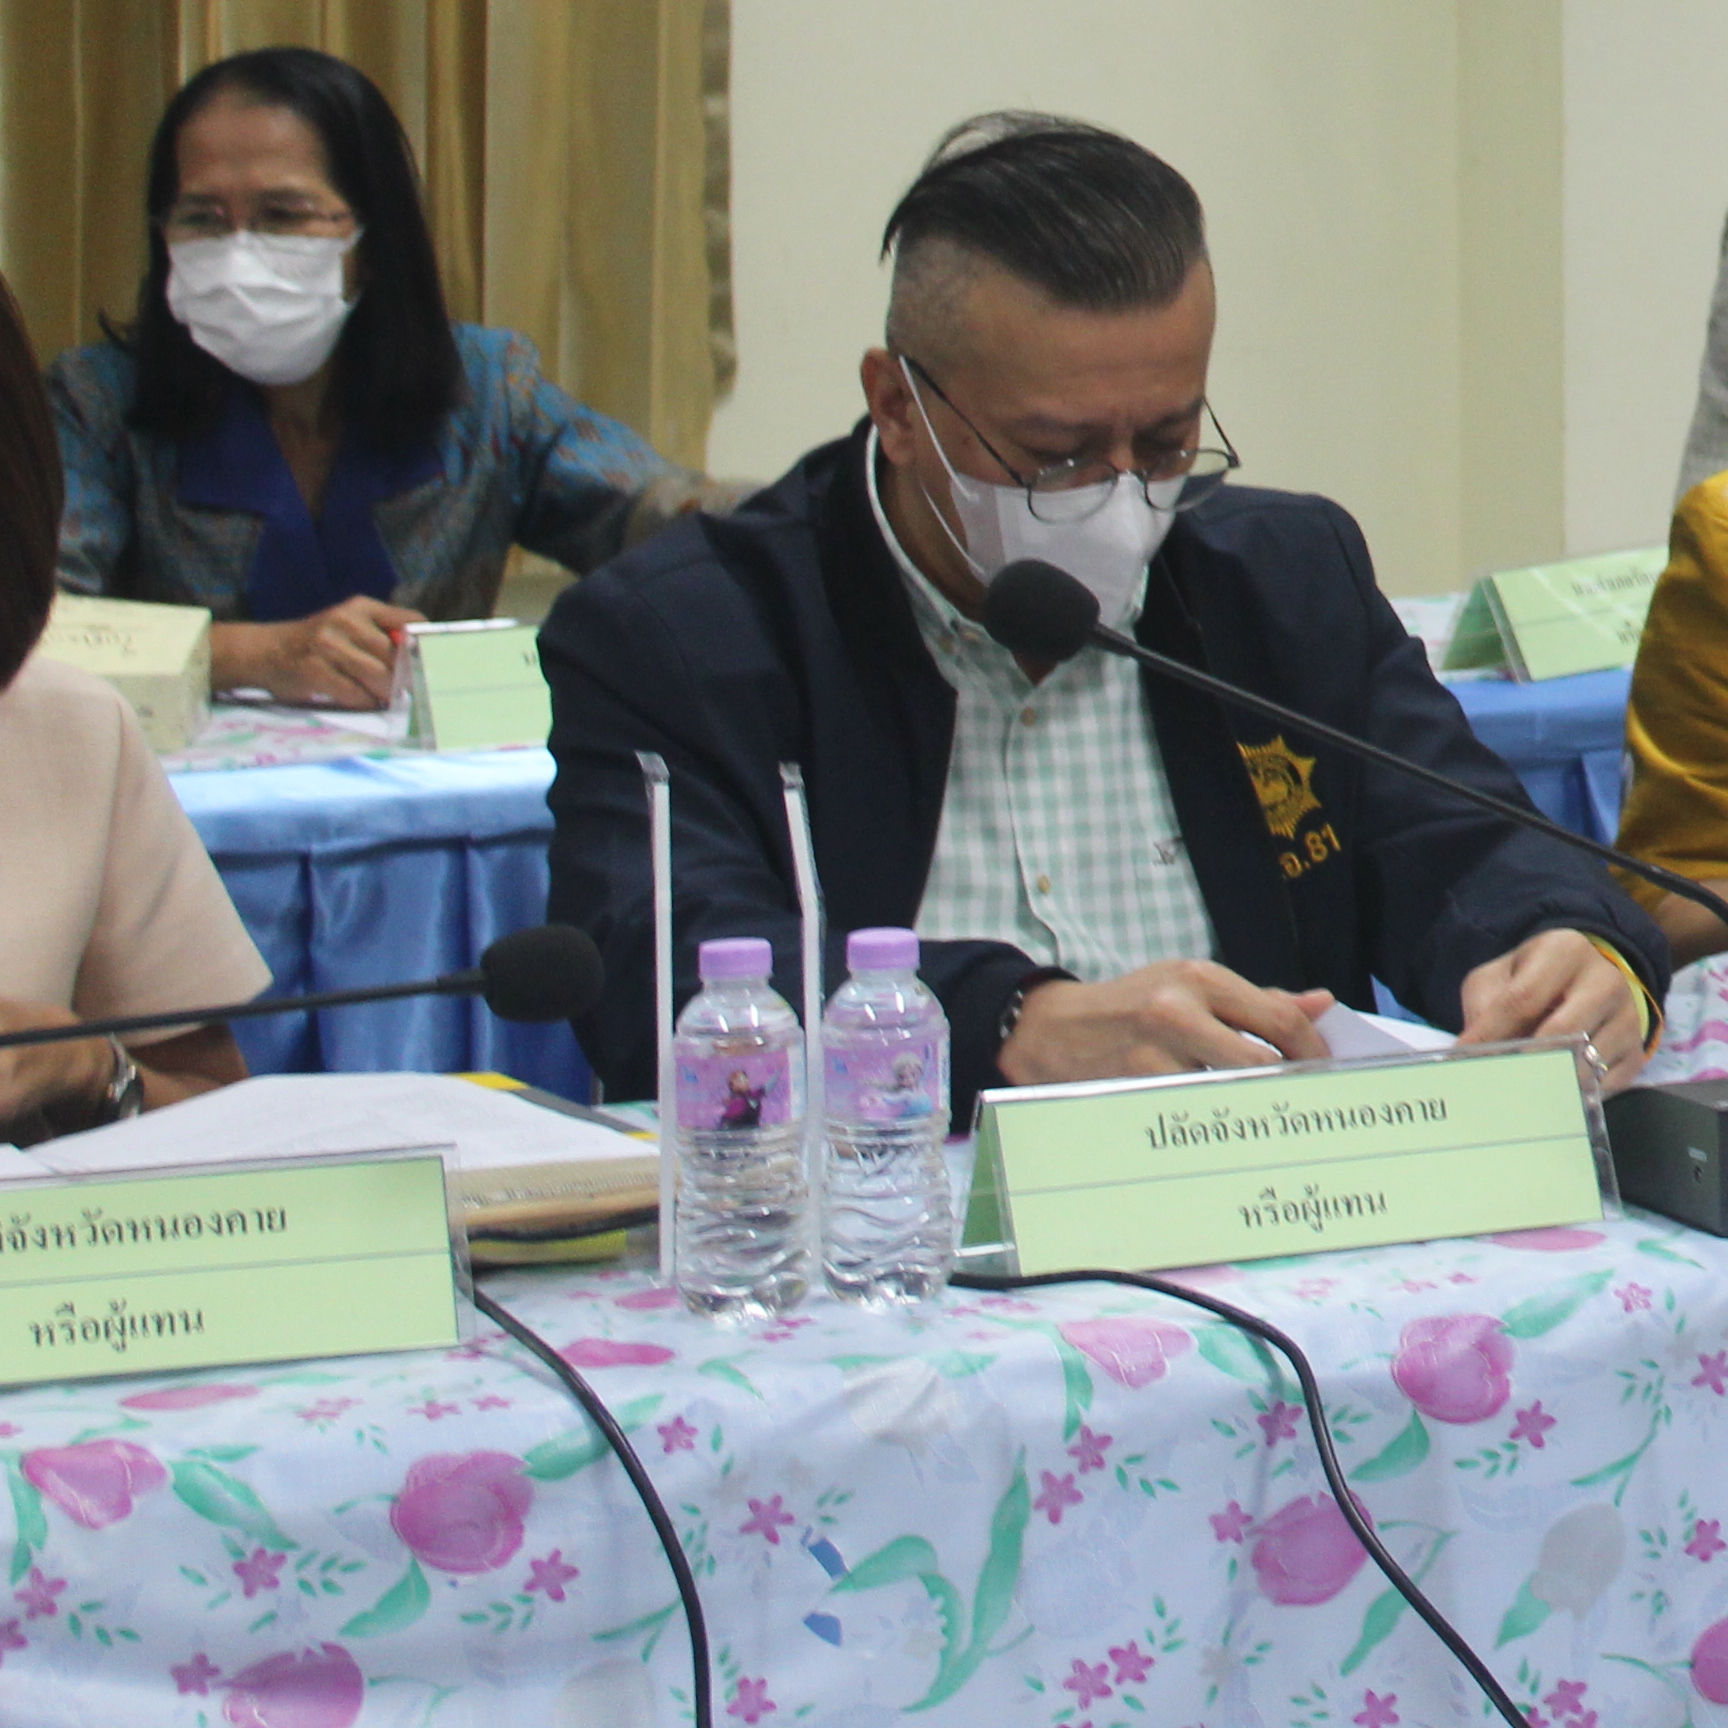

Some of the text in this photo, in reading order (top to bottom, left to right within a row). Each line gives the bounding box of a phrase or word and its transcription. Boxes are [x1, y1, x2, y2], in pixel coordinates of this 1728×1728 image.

[1144, 1097, 1449, 1151] ปลัดจังหวัดหนองคาย
[0, 1205, 288, 1255] จังหวัดหนองคาย
[1238, 1183, 1389, 1232] หรือผู้แทน
[29, 1298, 205, 1352] หรือผู้แทน
